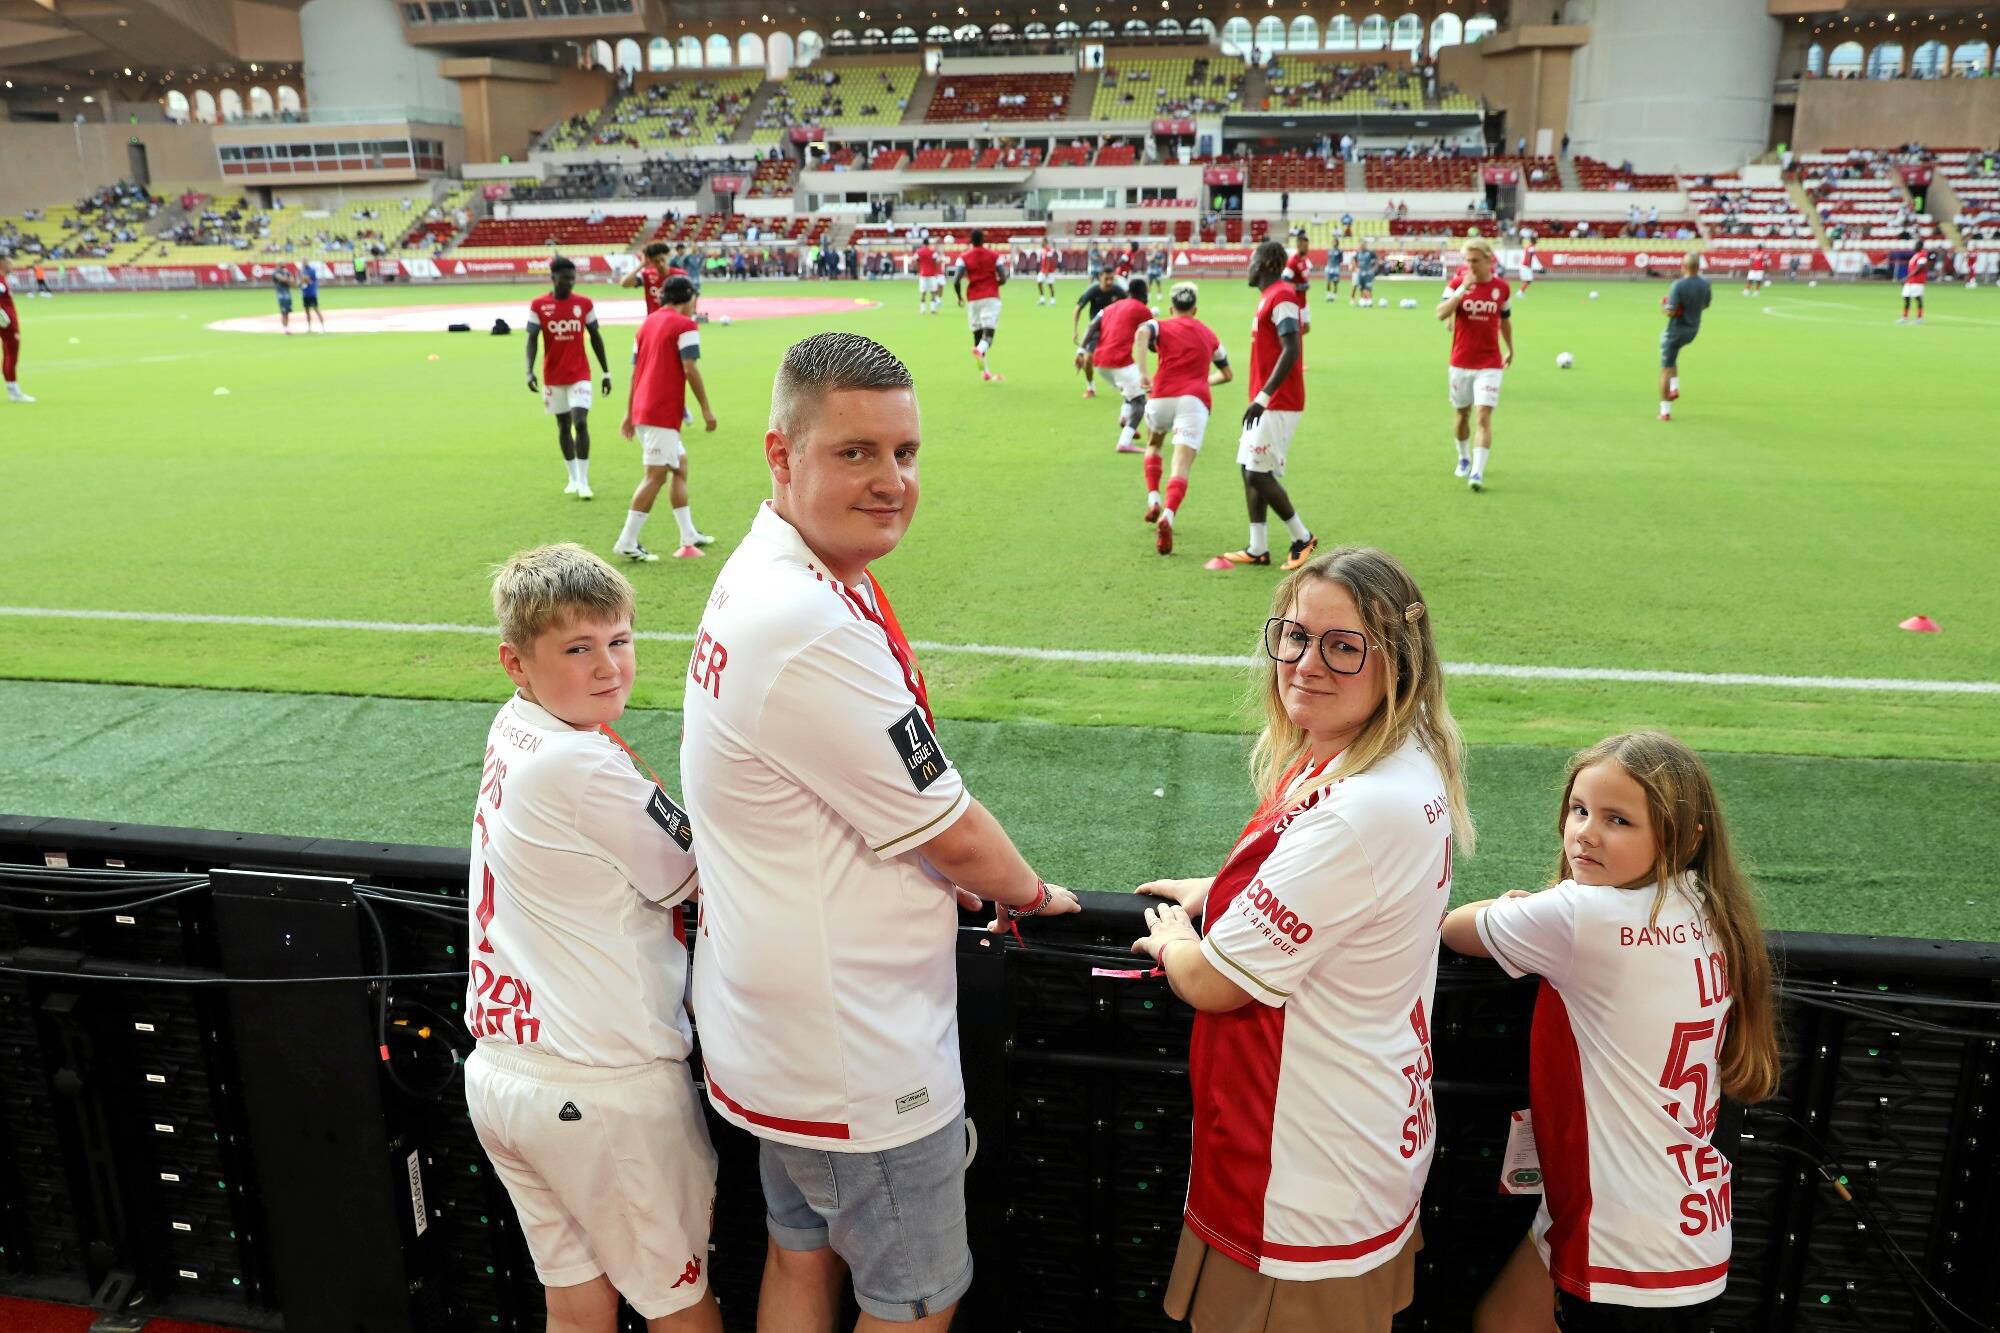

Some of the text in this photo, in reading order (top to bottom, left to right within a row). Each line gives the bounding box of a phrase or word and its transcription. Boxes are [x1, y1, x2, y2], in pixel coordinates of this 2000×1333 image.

[1463, 299, 1498, 315] apm
[548, 320, 581, 335] apm
[1246, 878, 1313, 945] CONGO
[1242, 907, 1298, 957] L'AFRIQUE
[1619, 924, 1686, 947] BANG
